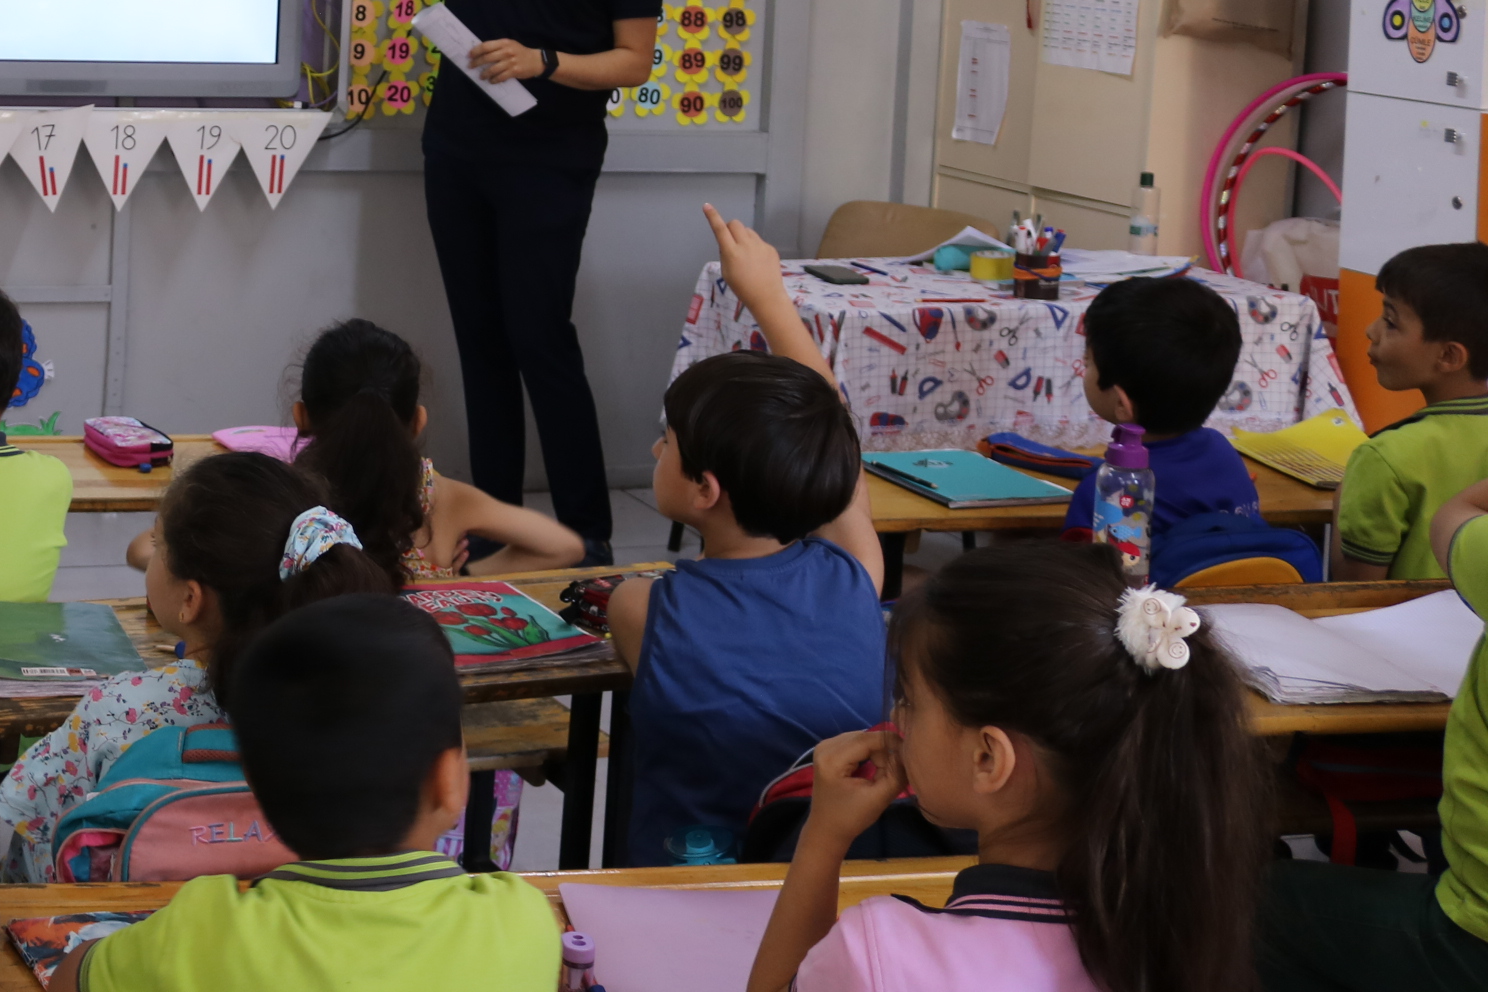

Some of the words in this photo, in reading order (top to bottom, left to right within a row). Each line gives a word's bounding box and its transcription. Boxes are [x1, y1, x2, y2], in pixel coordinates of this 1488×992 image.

[355, 5, 366, 21] 8
[353, 44, 365, 59] 9
[387, 43, 409, 59] 19
[348, 89, 369, 105] 10
[387, 88, 411, 103] 20
[639, 87, 660, 104] 80
[681, 96, 704, 112] 90
[722, 97, 743, 109] 100
[31, 124, 56, 150] 17
[111, 125, 136, 150] 18
[197, 126, 221, 150] 19
[265, 125, 296, 150] 20
